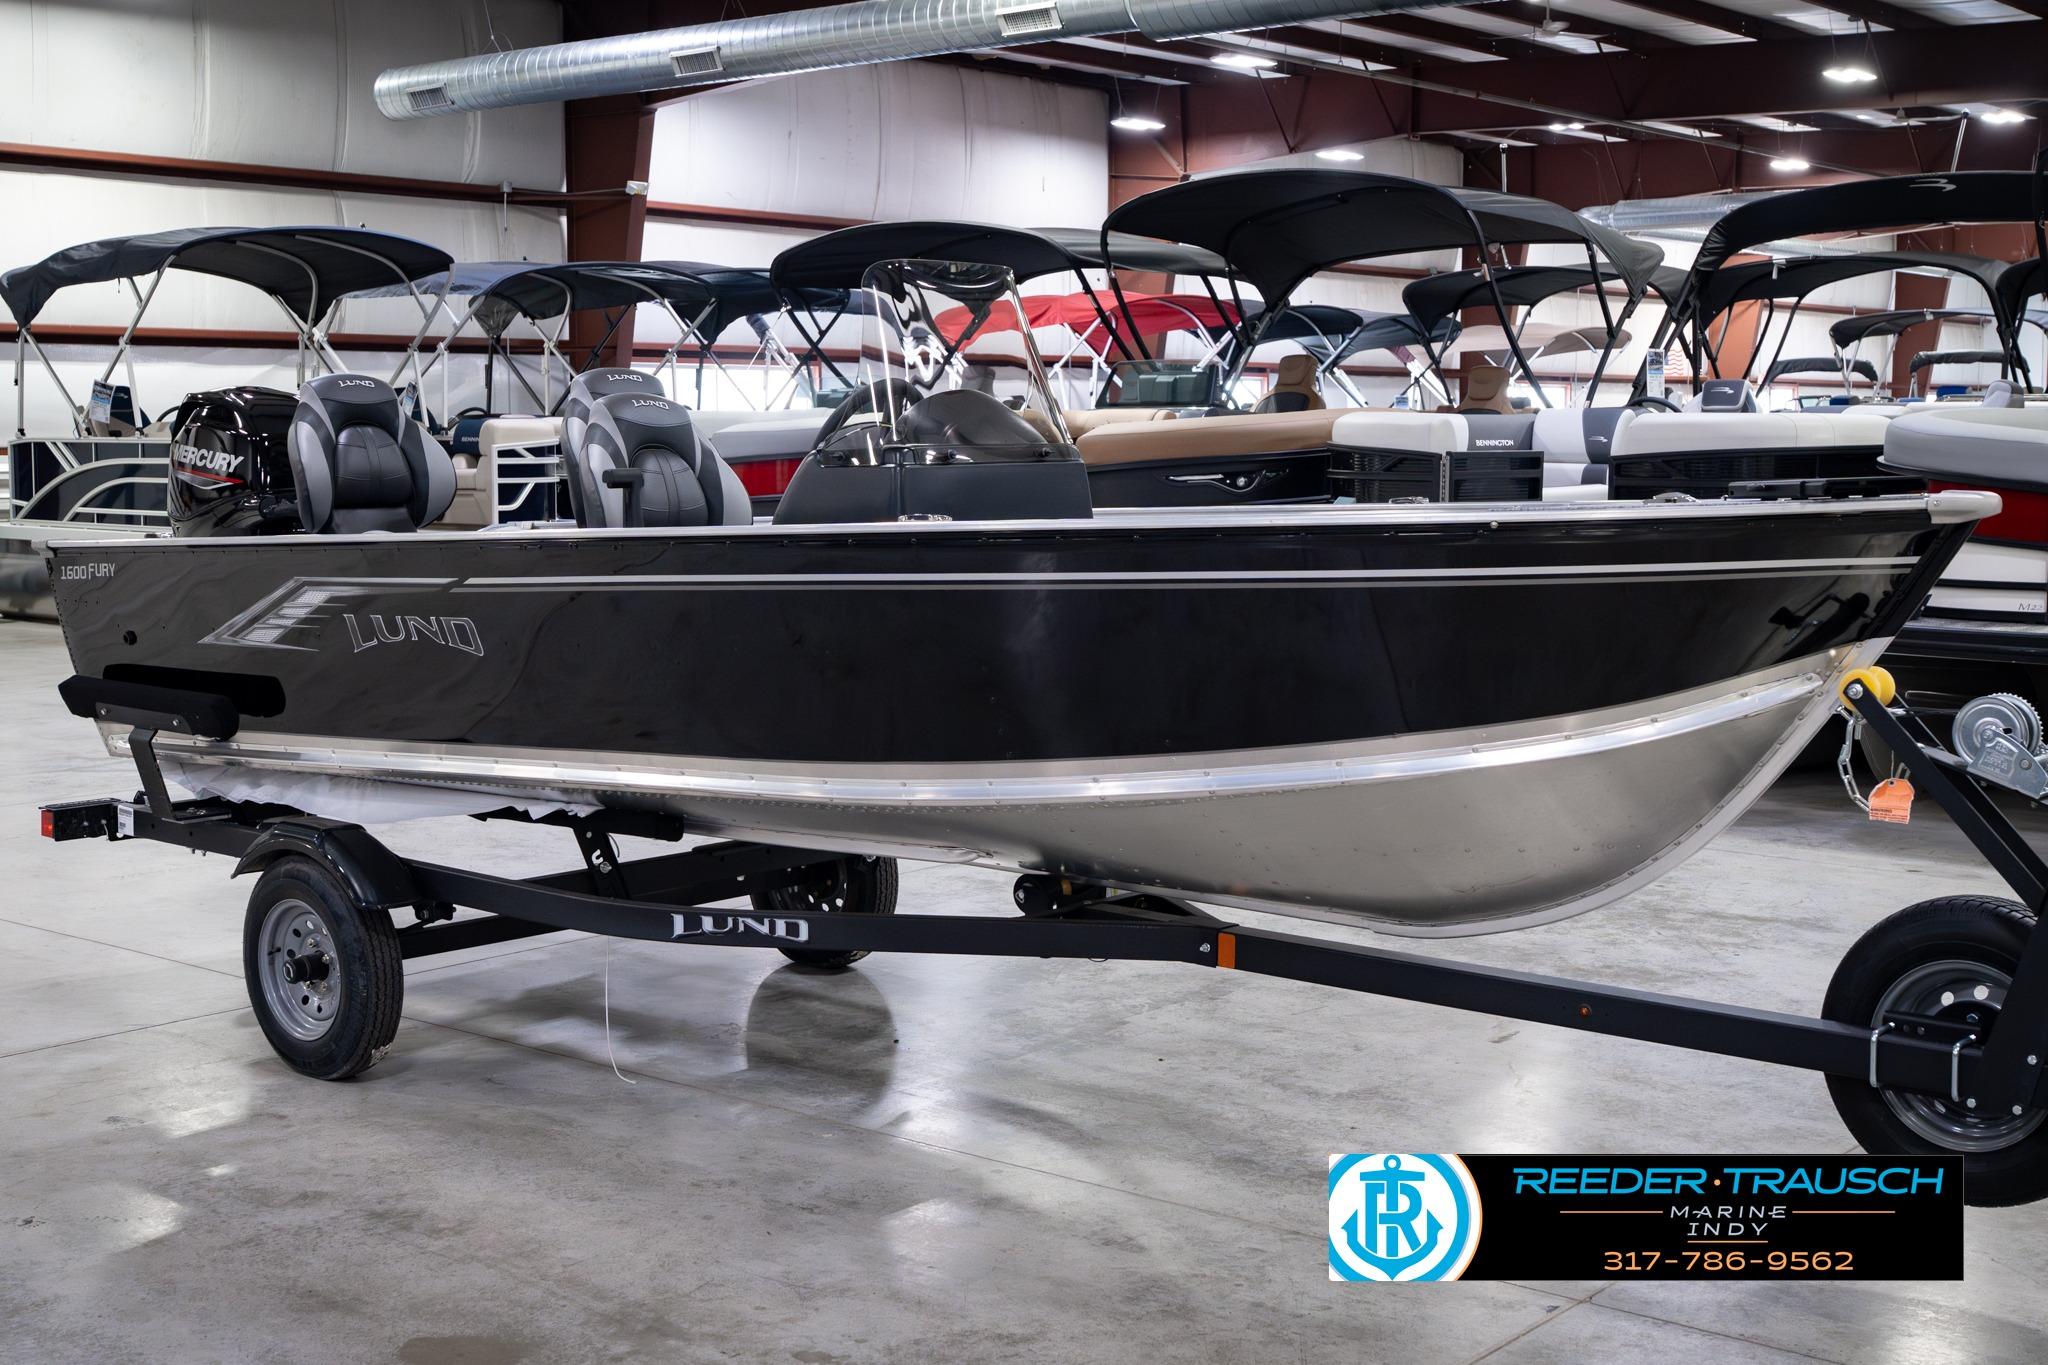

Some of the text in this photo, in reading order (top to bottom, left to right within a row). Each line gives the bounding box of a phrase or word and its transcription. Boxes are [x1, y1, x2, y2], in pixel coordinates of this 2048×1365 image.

[338, 380, 375, 388] LUND
[606, 374, 643, 382] LUND
[632, 399, 669, 410] LUND
[1475, 439, 1514, 447] BENNINGTON
[175, 443, 245, 473] MERCURY
[60, 562, 116, 580] 1600 FURY
[342, 613, 485, 657] LUND
[670, 912, 809, 942] LUND
